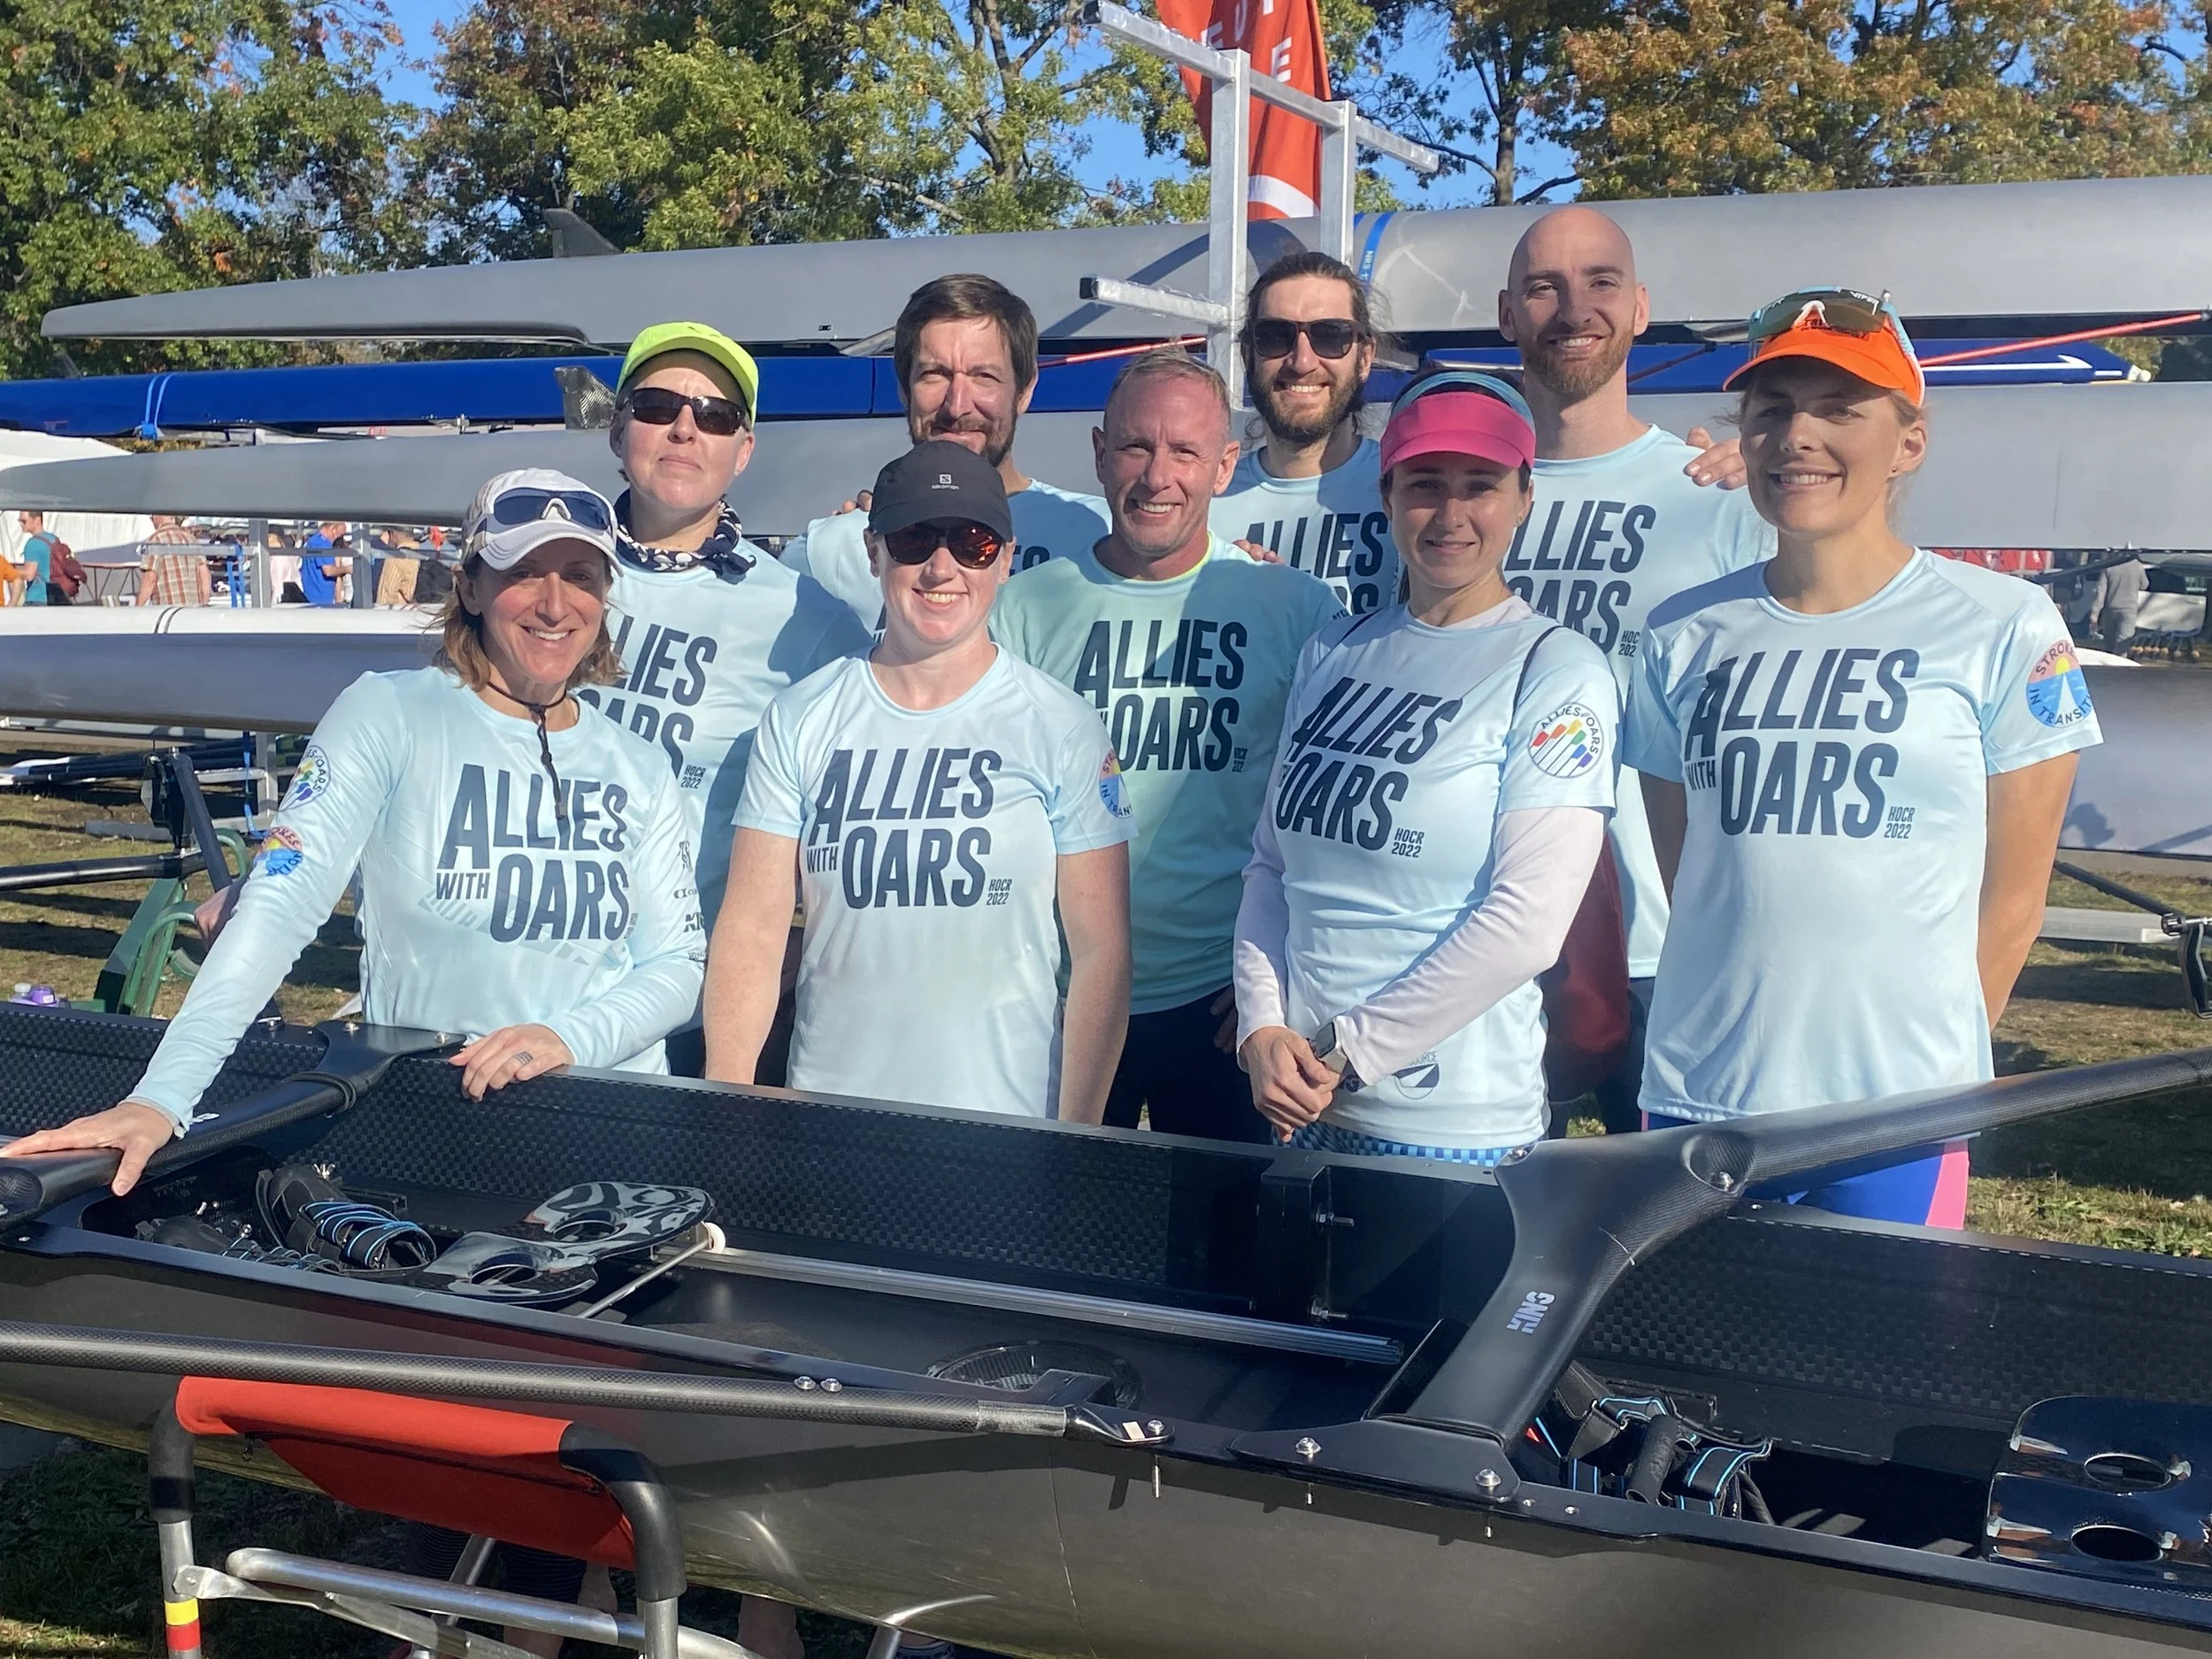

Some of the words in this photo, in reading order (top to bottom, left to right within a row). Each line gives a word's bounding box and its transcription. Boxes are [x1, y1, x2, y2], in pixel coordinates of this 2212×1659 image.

[1505, 500, 1656, 573] LLIES
[1618, 643, 1637, 657] 202
[1621, 630, 1640, 644] HOC
[614, 615, 718, 706] LIES
[1073, 619, 1248, 709] ALLIES
[1284, 676, 1463, 764] ALLIES
[1685, 649, 1921, 762] ALLIES
[2039, 695, 2092, 726] TRANSIT
[1110, 694, 1240, 772] OARS
[1540, 706, 1581, 729] ALLIES
[1586, 717, 1601, 754] OARS
[680, 776, 702, 789] 2022
[1686, 759, 1717, 791] WITH
[1721, 736, 1900, 839] OARS
[436, 763, 628, 870] ALLIES
[807, 748, 1003, 847] ALLIES
[1276, 752, 1409, 851] OARS
[1887, 806, 1916, 823] HOCR
[1391, 842, 1422, 858] 2022
[1394, 827, 1425, 845] HOCR
[1884, 823, 1912, 839] 2022
[806, 846, 839, 874] WITH
[841, 826, 992, 910] OARS
[435, 872, 490, 900] WITH
[489, 853, 630, 943] OARS
[986, 892, 1010, 906] 2022
[988, 879, 1012, 892] HOCR
[1506, 1291, 1555, 1334] KING
